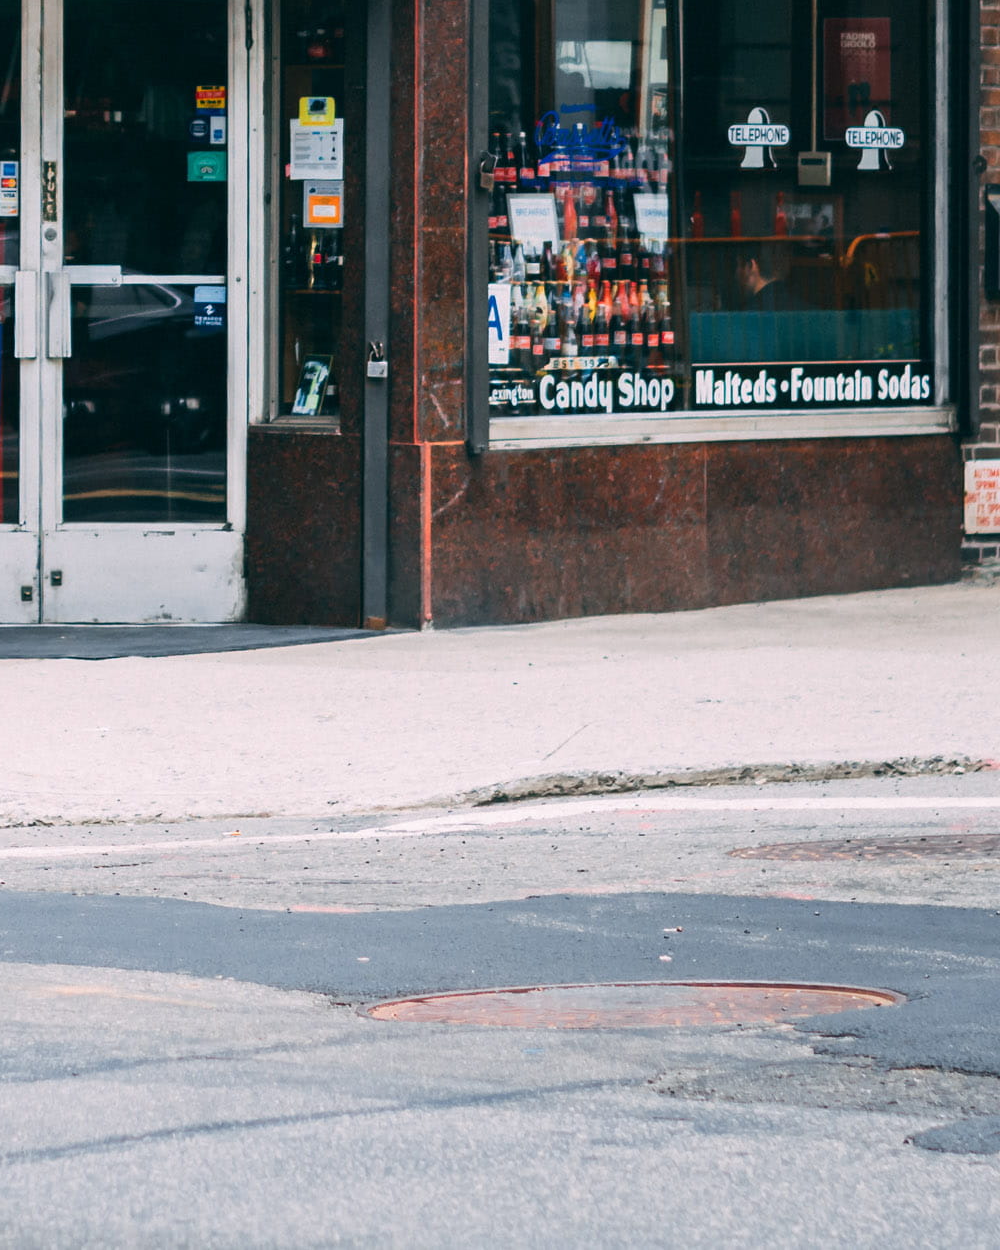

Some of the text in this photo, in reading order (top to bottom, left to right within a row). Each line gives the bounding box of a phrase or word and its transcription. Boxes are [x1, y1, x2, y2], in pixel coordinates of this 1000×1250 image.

[729, 127, 786, 143] TELEPHONE
[847, 130, 901, 146] TELEPHONE
[539, 372, 613, 414] Candy
[617, 372, 675, 412] Shop
[695, 364, 930, 406] Malteds Fountain Sodas
